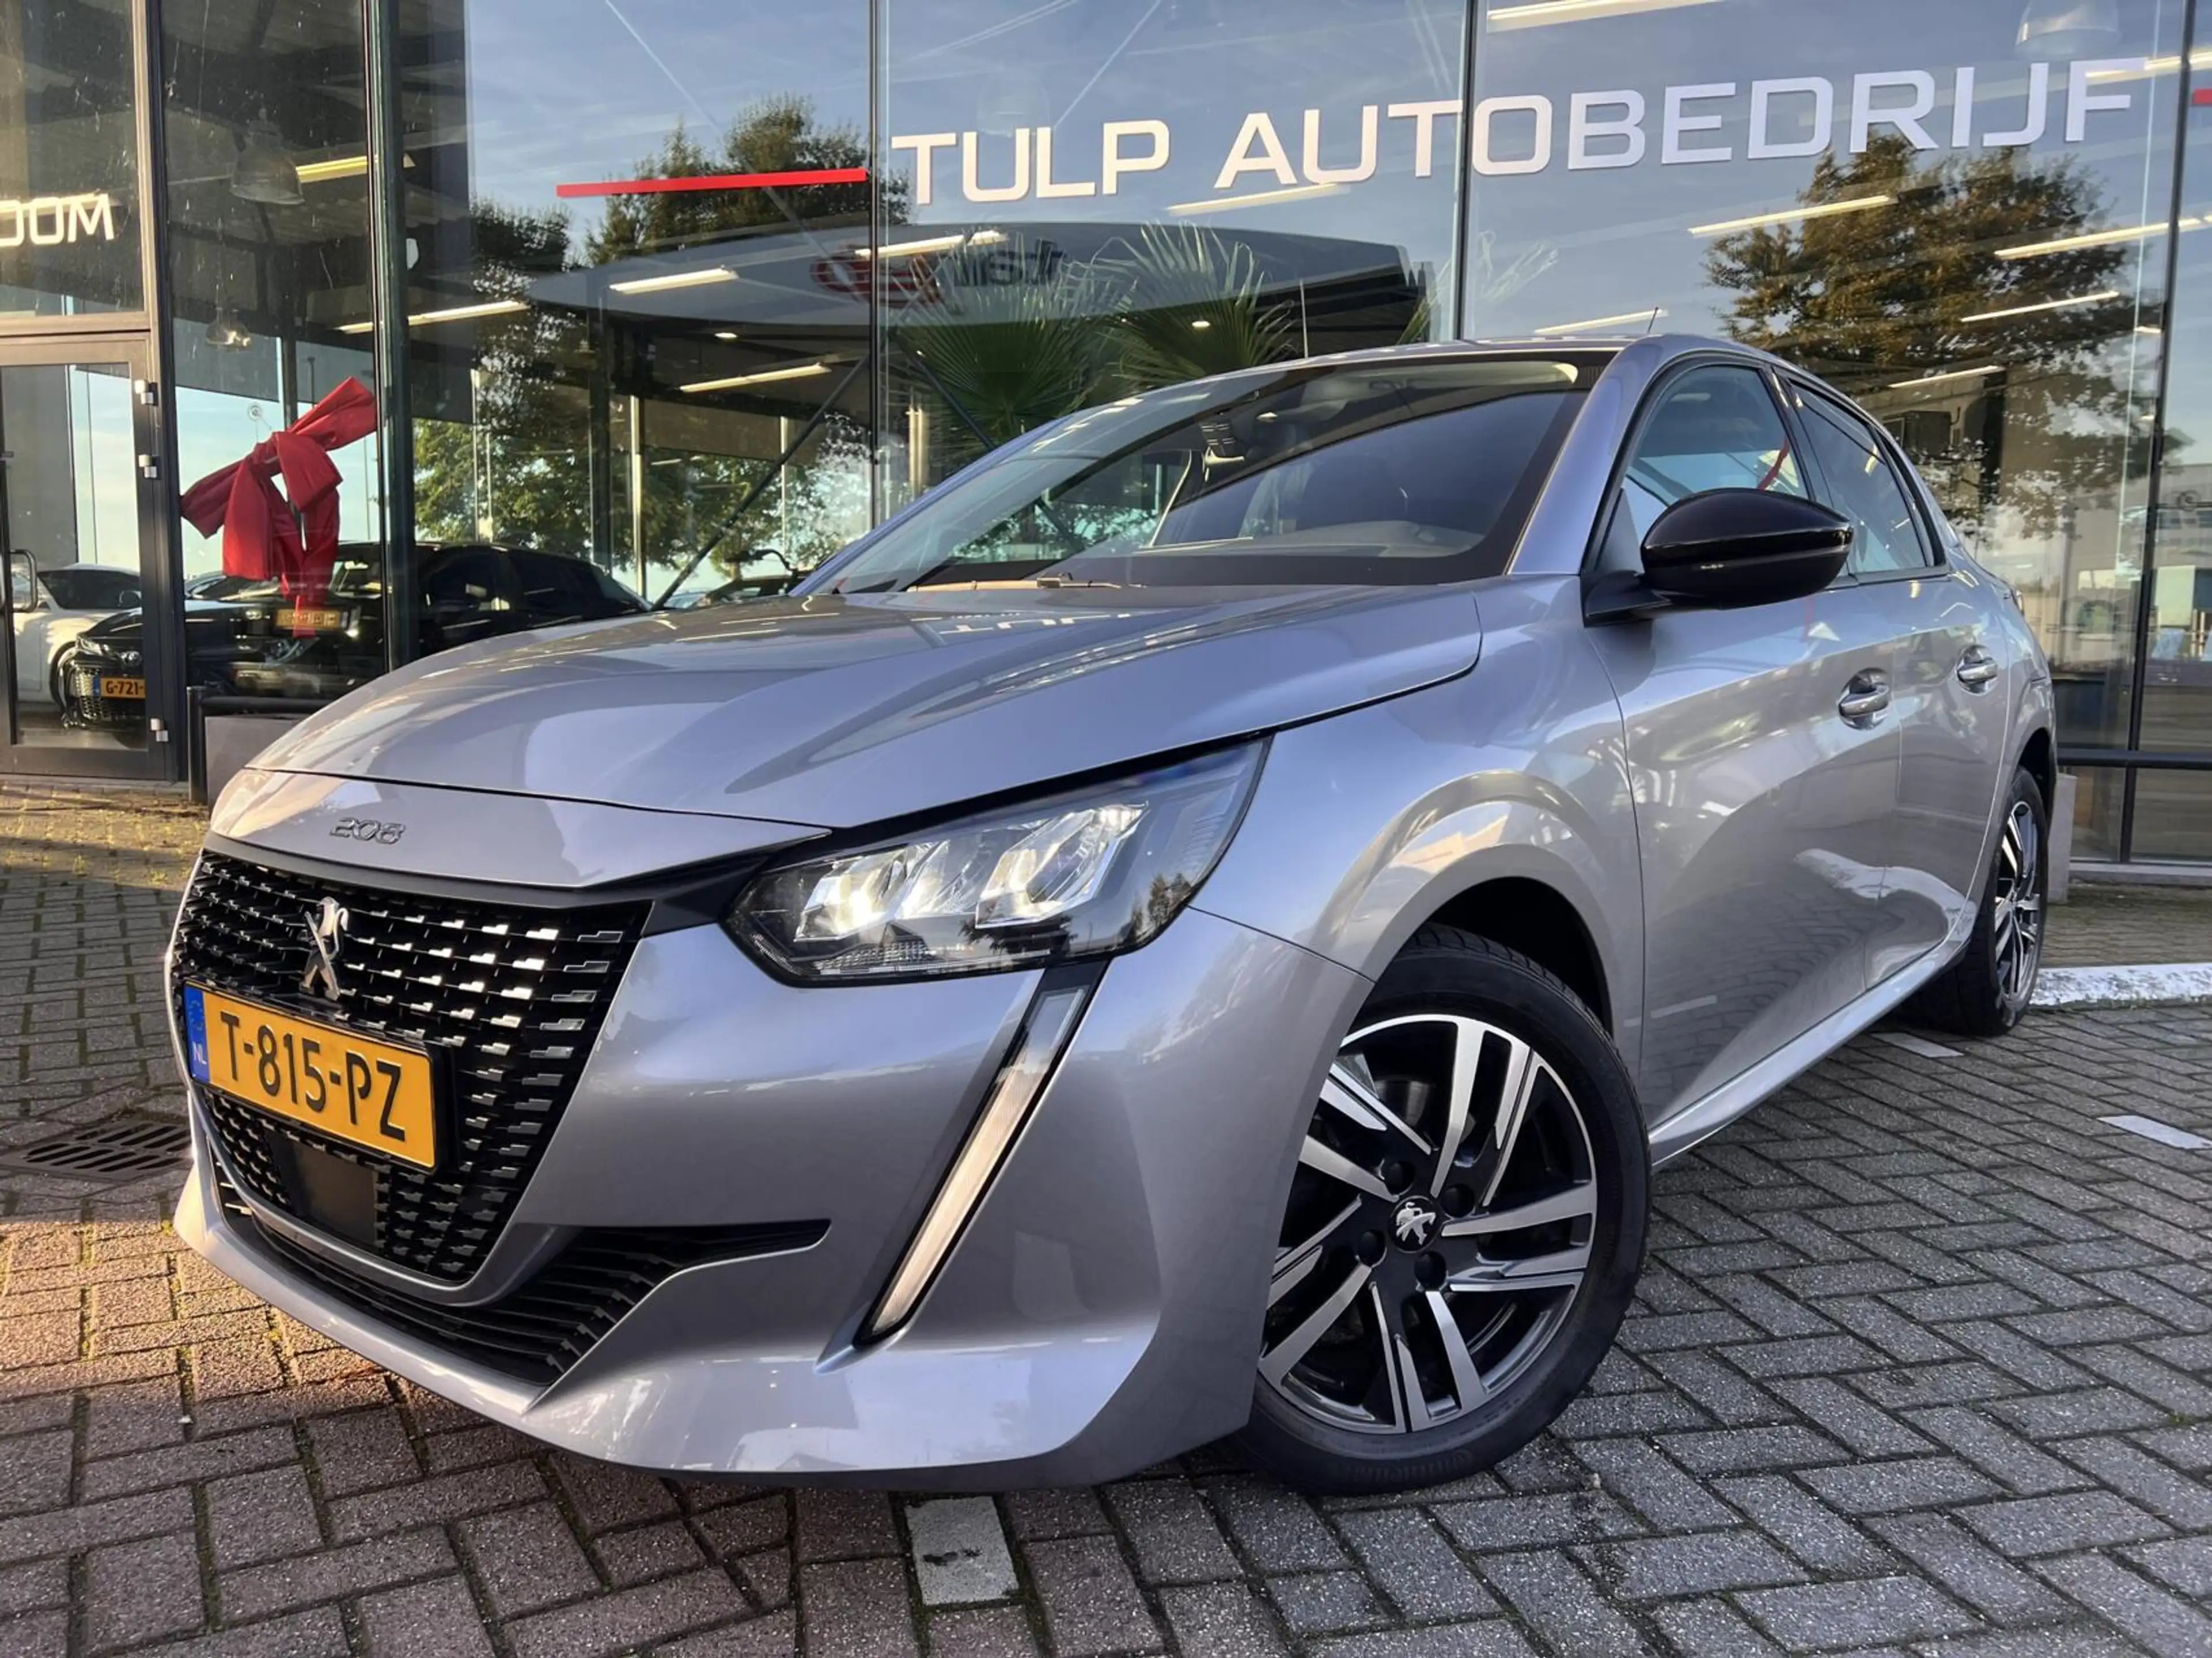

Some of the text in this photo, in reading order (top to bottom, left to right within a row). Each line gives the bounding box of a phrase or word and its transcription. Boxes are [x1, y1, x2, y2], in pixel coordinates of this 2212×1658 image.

[891, 56, 2147, 205] TULP AUTOBEDRIJF
[329, 817, 406, 844] 208
[192, 1011, 406, 1143] NL T-815-PZ
